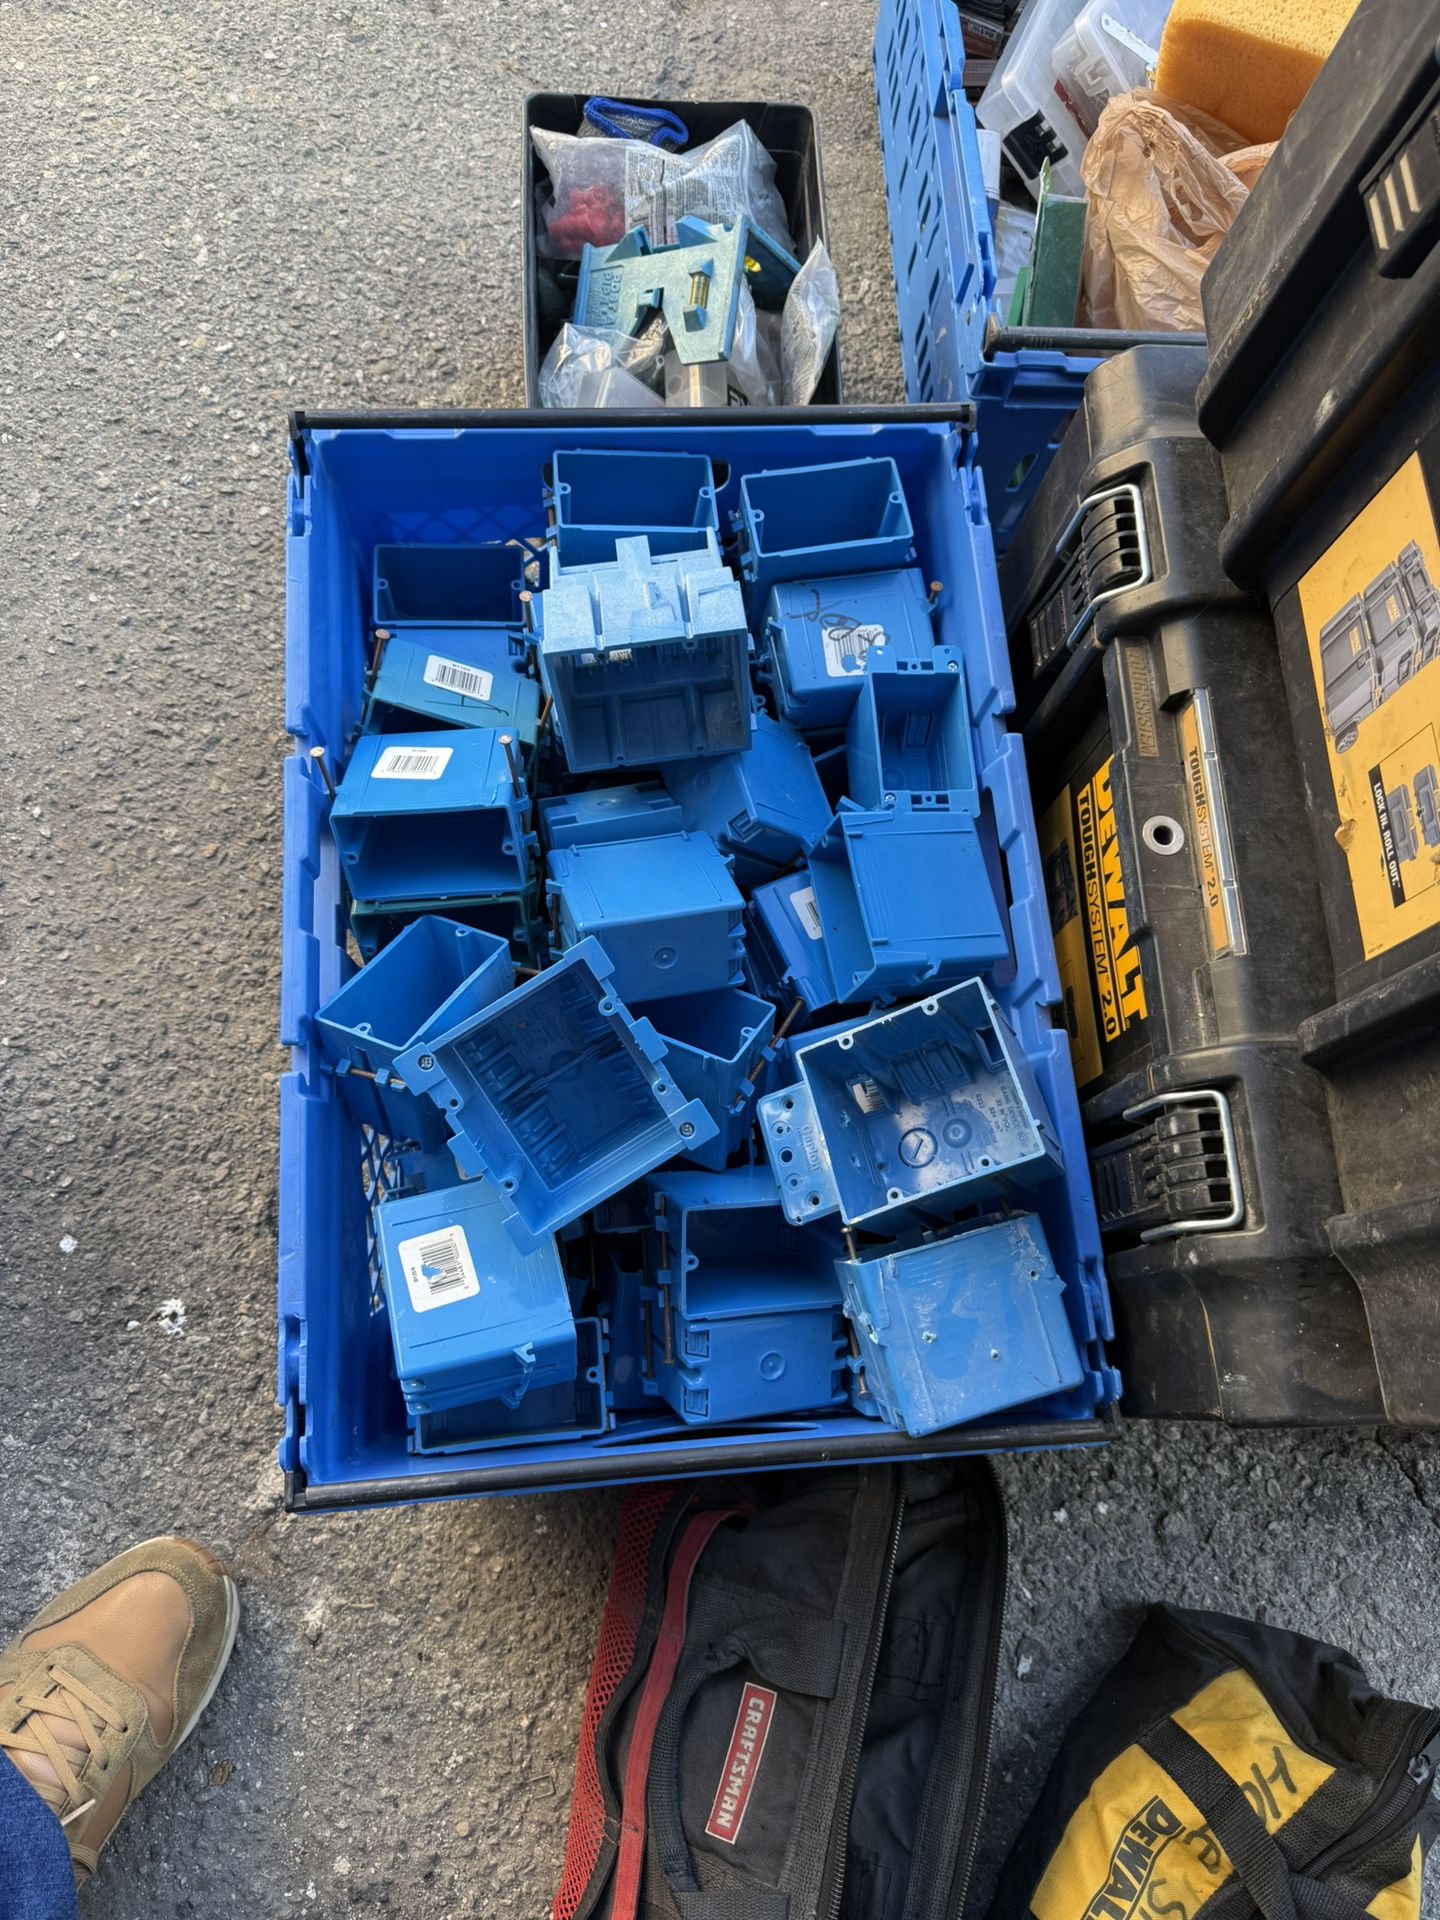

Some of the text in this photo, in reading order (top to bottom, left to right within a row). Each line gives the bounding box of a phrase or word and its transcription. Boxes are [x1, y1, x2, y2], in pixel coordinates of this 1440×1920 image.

[1127, 651, 1158, 756] TOUGHSYSTEM
[1094, 753, 1148, 1020] DEWALT
[1189, 745, 1219, 907] TOUGHSYSTEM 2.0
[1373, 782, 1400, 886] LOCK IN. ROLL OUT.
[1079, 790, 1117, 1037] TOUGHSYSTEM 2.0
[716, 1695, 765, 1830] CRAFTSMAN
[1081, 1798, 1183, 1920] DEWAL
